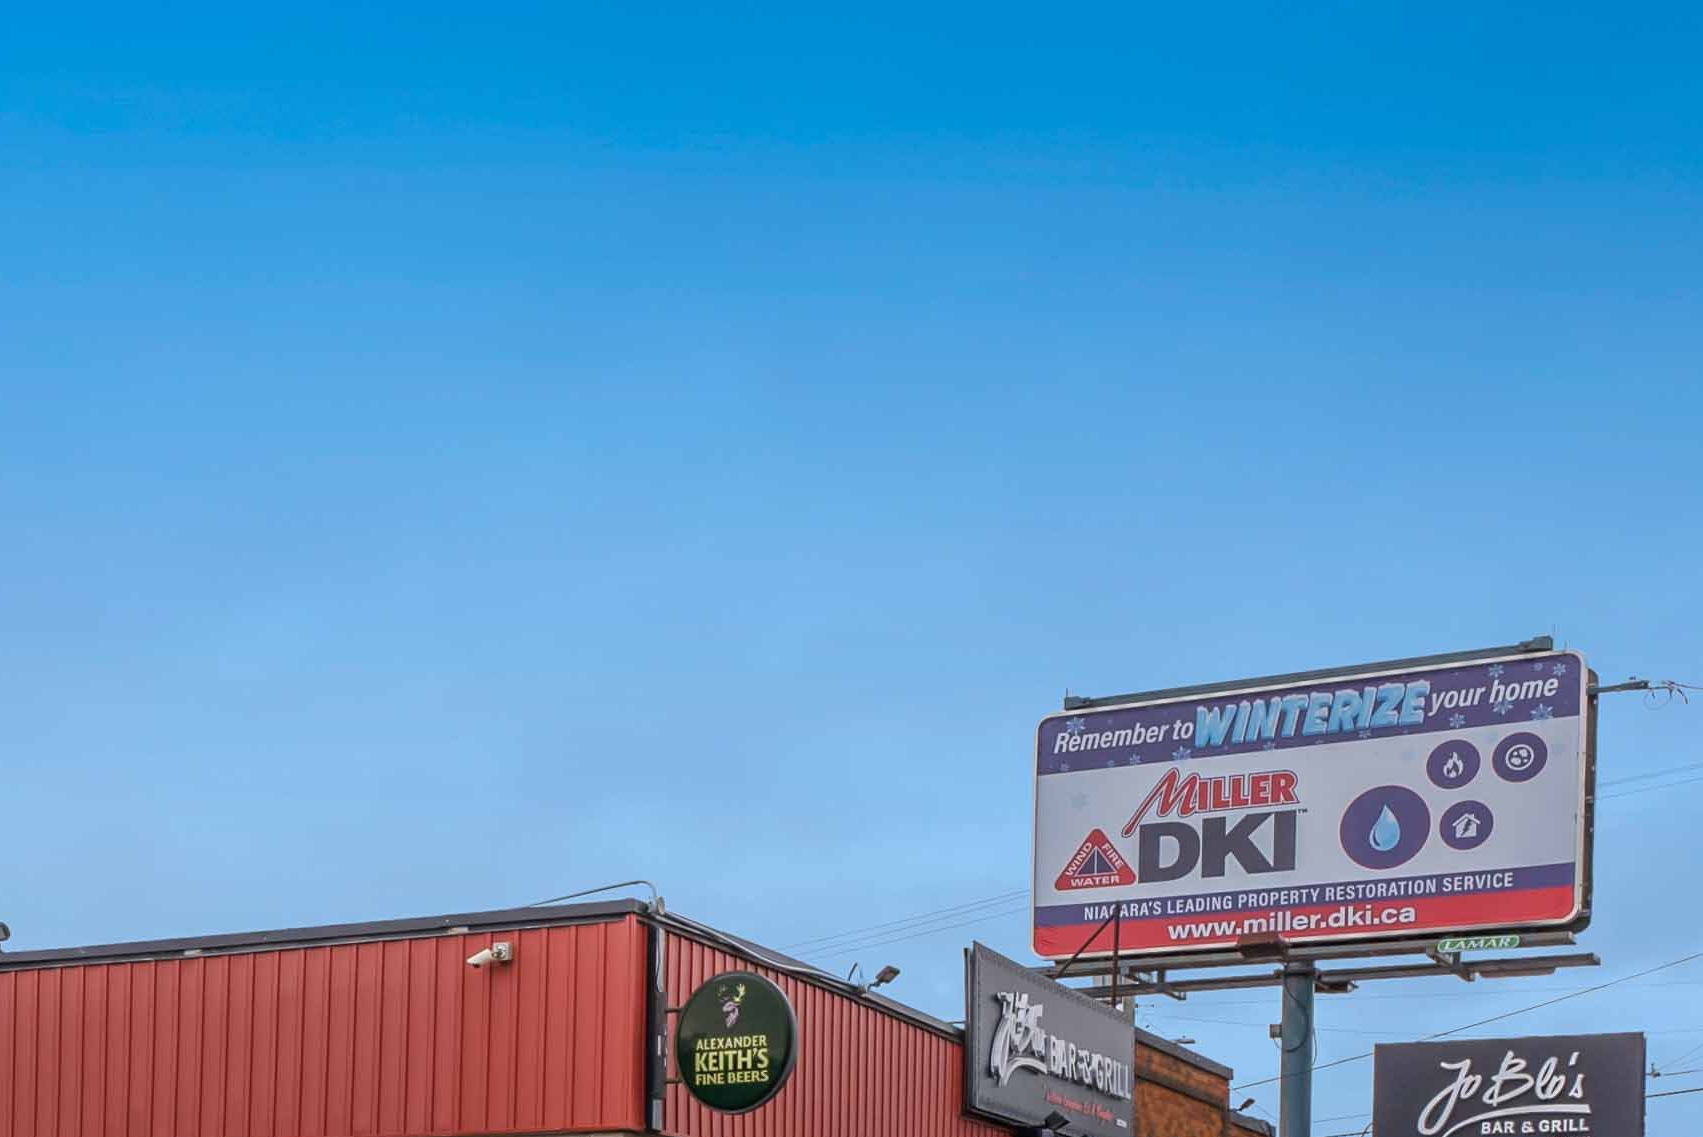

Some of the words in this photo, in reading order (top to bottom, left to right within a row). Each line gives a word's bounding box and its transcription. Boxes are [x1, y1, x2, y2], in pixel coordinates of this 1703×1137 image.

[1054, 722, 1169, 754] Remember
[1172, 719, 1194, 740] to
[1194, 680, 1431, 748] WINTERIZE
[1428, 686, 1486, 716] your
[1489, 678, 1559, 704] home
[1122, 767, 1299, 838] MILLER
[1066, 842, 1092, 876] WIND
[1101, 842, 1124, 870] FIRE
[1138, 810, 1297, 884] DKI
[1070, 875, 1120, 887] WATER
[1167, 895, 1233, 914] LEADING
[1238, 887, 1319, 908] PROPERTY
[1325, 878, 1436, 901] RESTORATION
[1442, 872, 1514, 892] SERVICE
[1167, 904, 1416, 940] www.miller.dki.ca
[1445, 936, 1512, 950] LAMAR
[696, 1034, 767, 1051] ALEXANDER
[694, 1047, 769, 1073] KEITH'S
[695, 1071, 725, 1086] FINE
[728, 1069, 769, 1084] BEERS
[1481, 1120, 1515, 1135] BAR
[1521, 1120, 1535, 1133] &
[1538, 1117, 1589, 1132] GRILL
